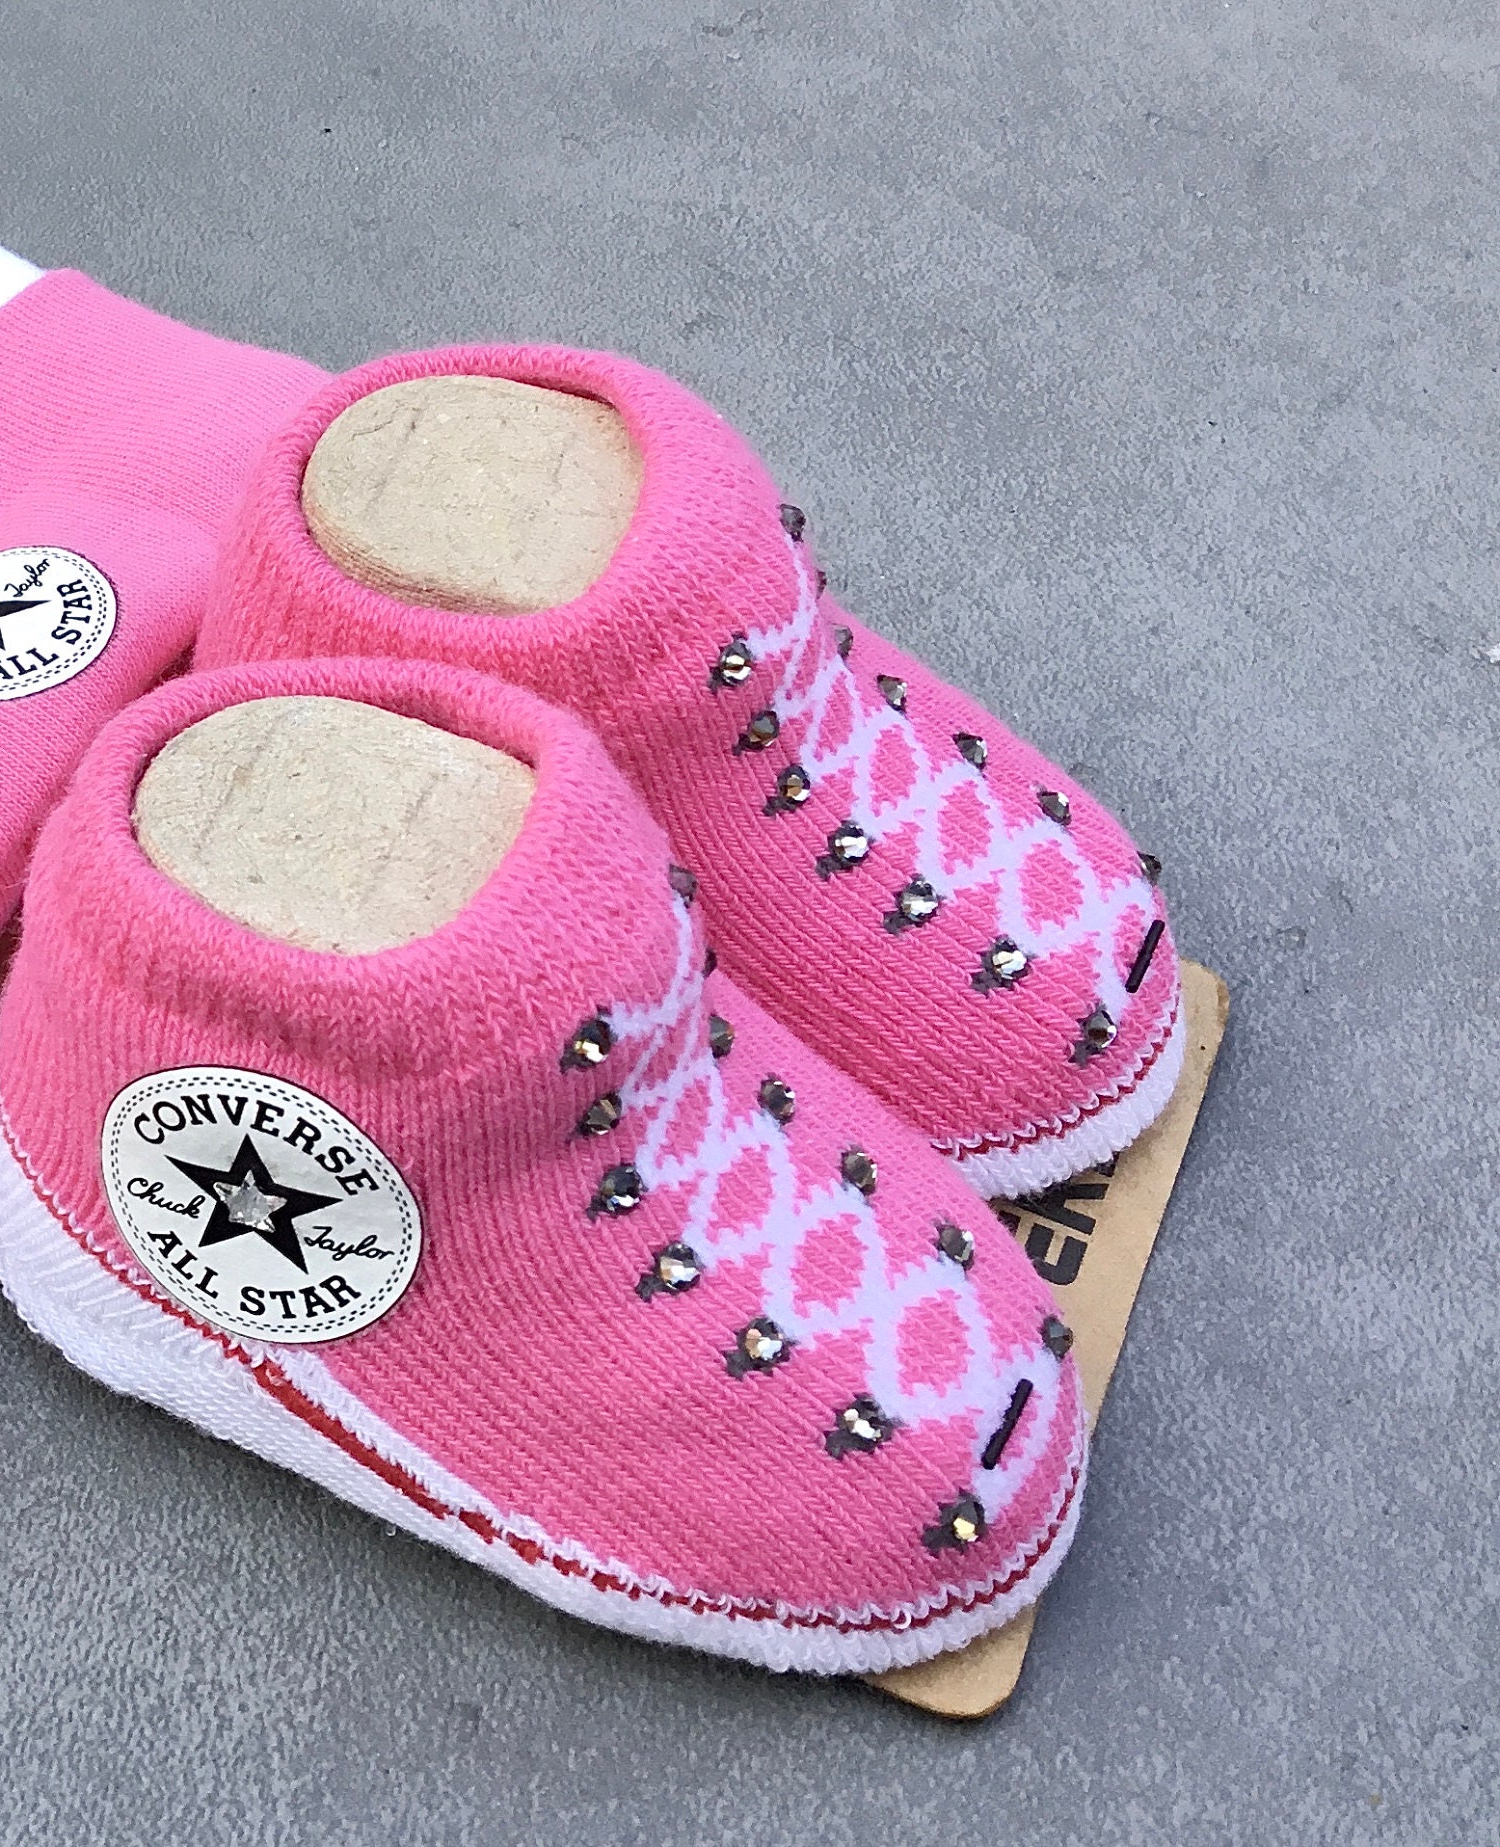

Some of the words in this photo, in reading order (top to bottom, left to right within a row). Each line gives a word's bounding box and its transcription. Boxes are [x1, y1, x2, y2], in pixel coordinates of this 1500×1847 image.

[3, 558, 51, 598] Taylor
[51, 578, 93, 646] STAR
[133, 1093, 380, 1196] CONVERSE
[126, 1176, 206, 1220] Chuck
[303, 1225, 395, 1262] Taylor
[147, 1230, 219, 1300] ALL
[239, 1274, 362, 1320] STAR
